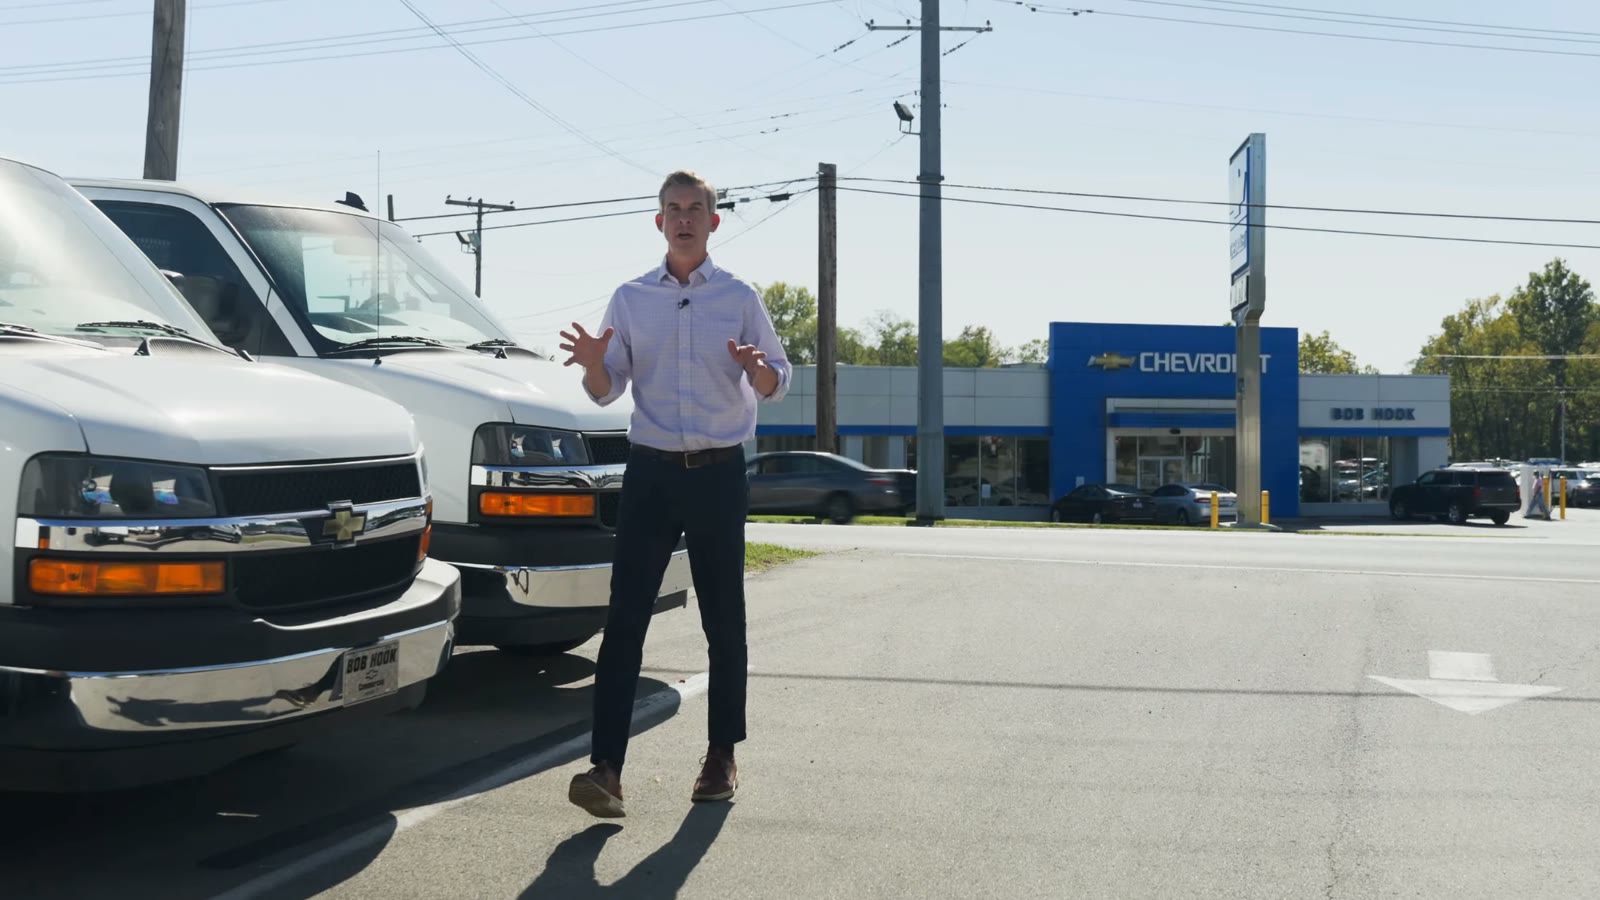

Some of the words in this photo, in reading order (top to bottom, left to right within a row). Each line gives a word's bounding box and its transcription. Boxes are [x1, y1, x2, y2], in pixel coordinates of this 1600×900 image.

[1140, 352, 1271, 373] CHEVROT
[1331, 408, 1364, 421] BOB
[1372, 408, 1416, 421] HOOK
[346, 655, 368, 674] BOB
[370, 648, 398, 668] HOOK
